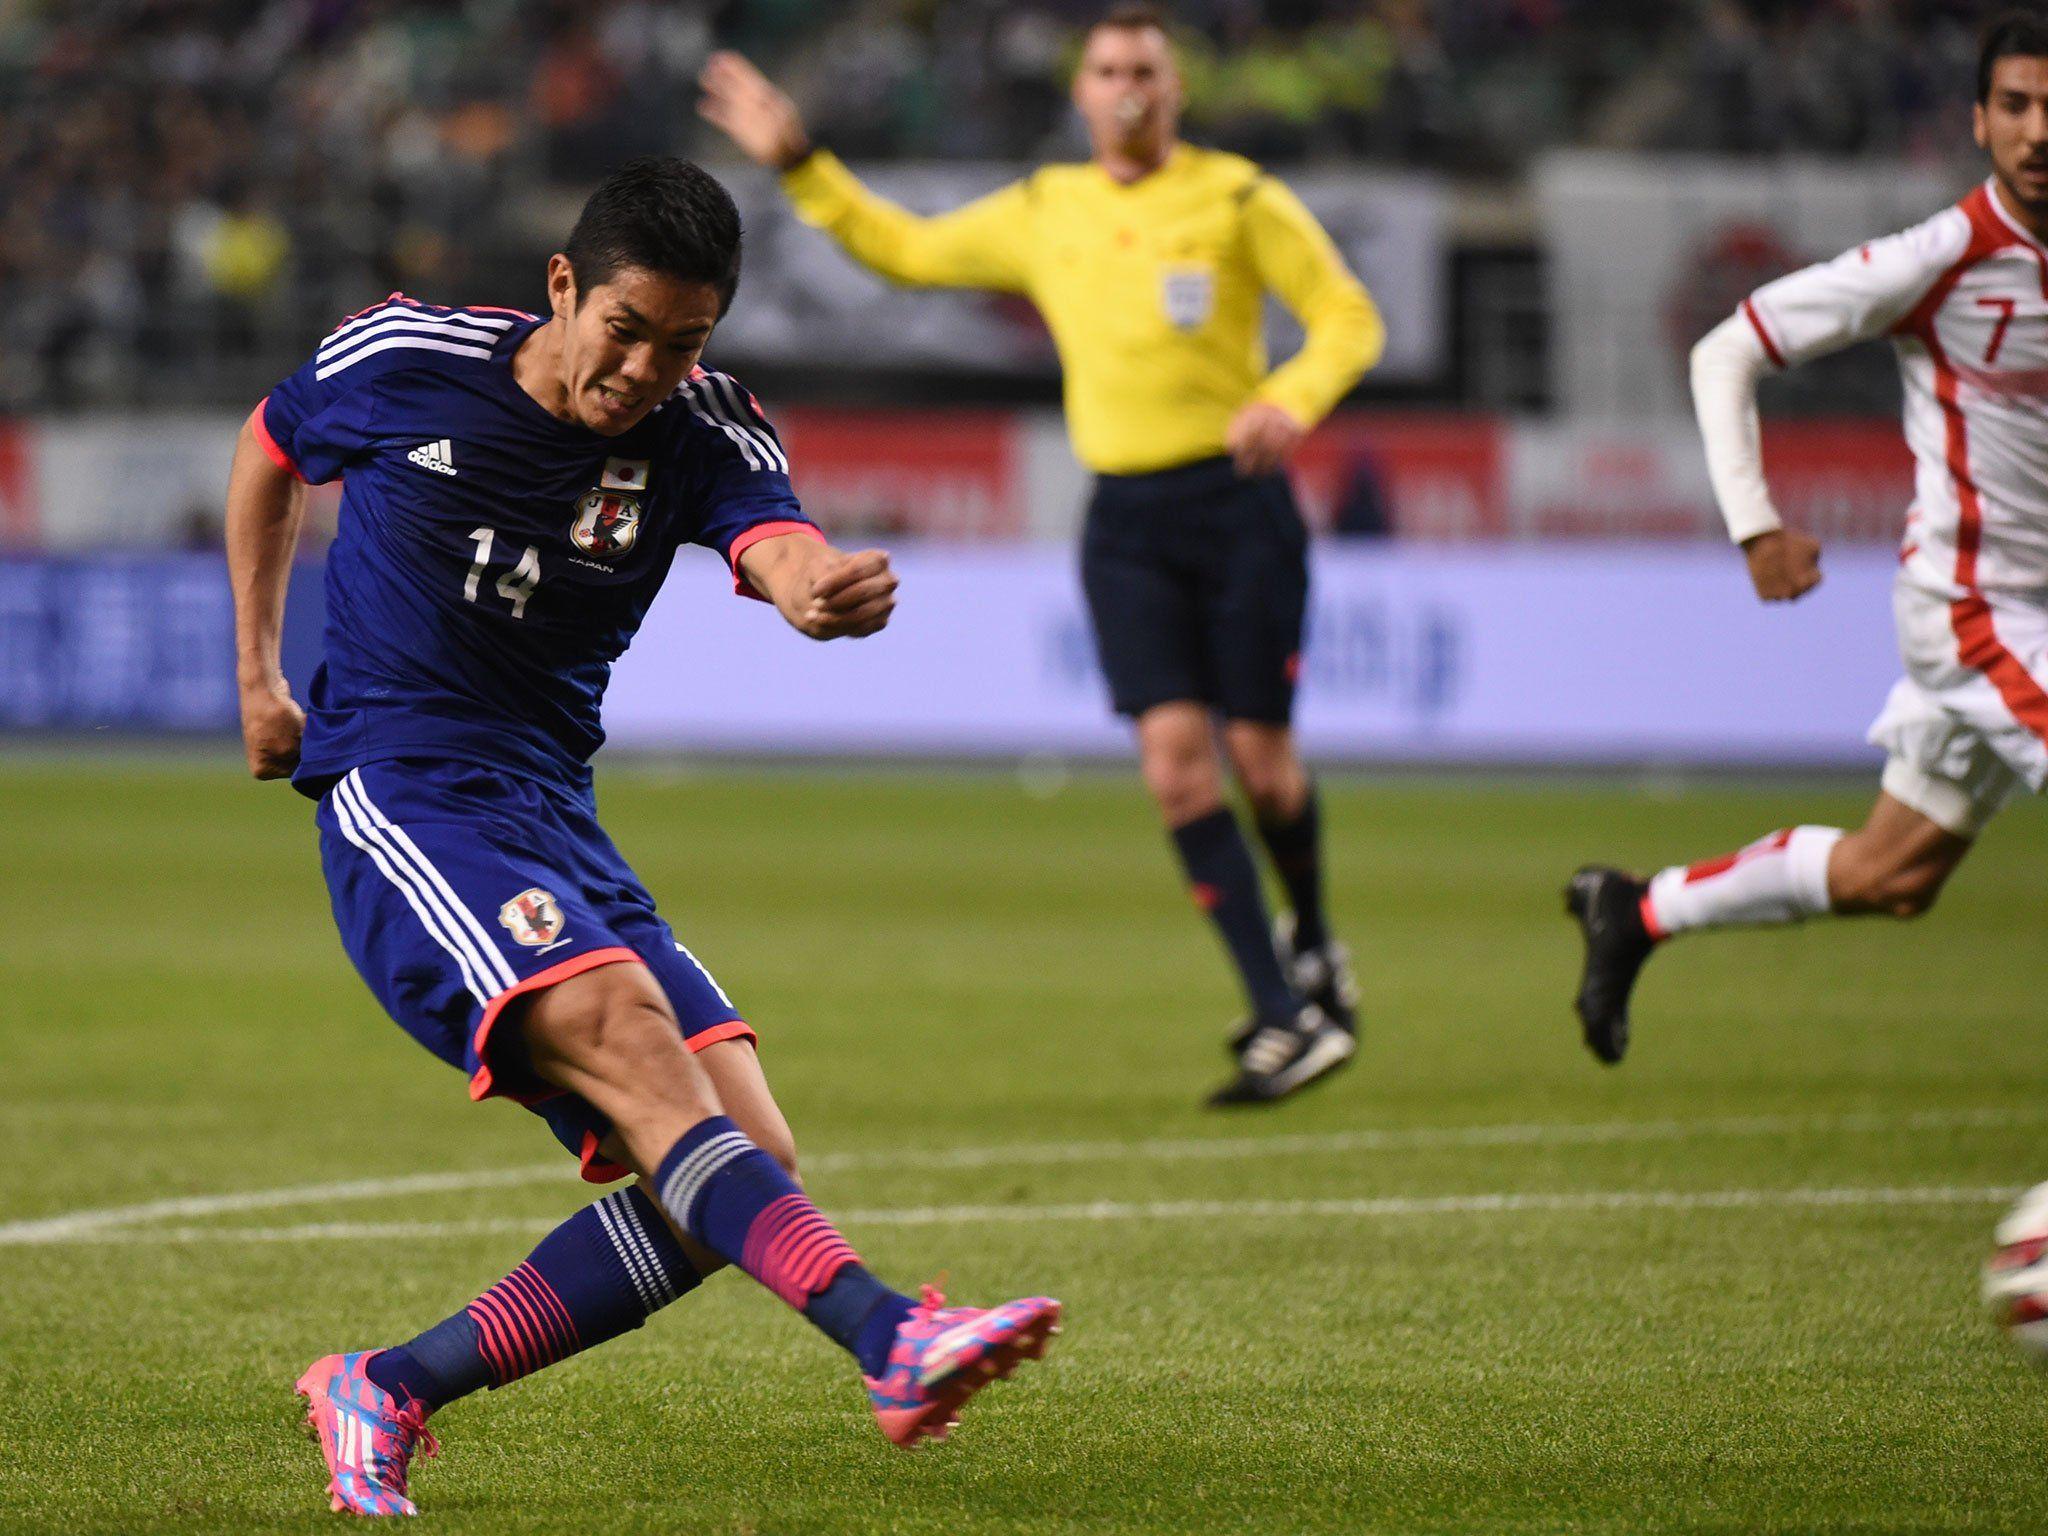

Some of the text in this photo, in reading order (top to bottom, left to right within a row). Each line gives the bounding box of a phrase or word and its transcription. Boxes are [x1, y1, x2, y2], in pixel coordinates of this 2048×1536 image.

[1976, 298, 2015, 363] 7
[407, 450, 458, 476] adidas
[463, 525, 541, 619] 14
[568, 557, 614, 574] JAPAN
